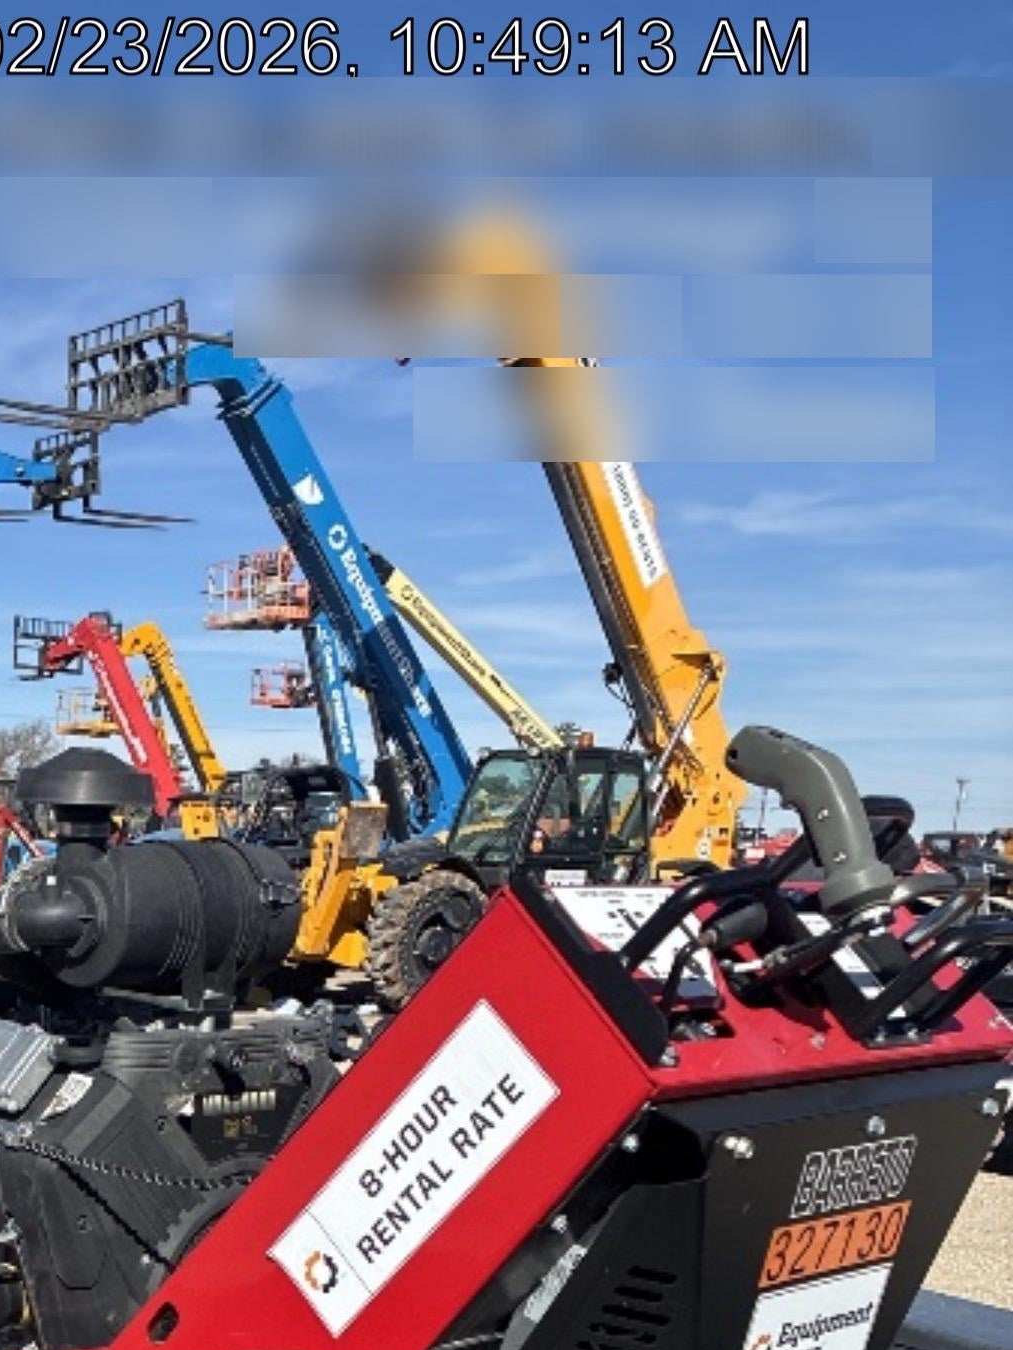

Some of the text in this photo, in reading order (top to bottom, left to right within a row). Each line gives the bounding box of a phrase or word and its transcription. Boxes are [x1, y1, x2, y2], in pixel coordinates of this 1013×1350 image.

[355, 1072, 526, 1265] RENTAL RATE
[358, 1084, 459, 1198] 8-HOUR
[766, 1206, 903, 1282] 327130
[776, 1301, 875, 1347] Equipment
